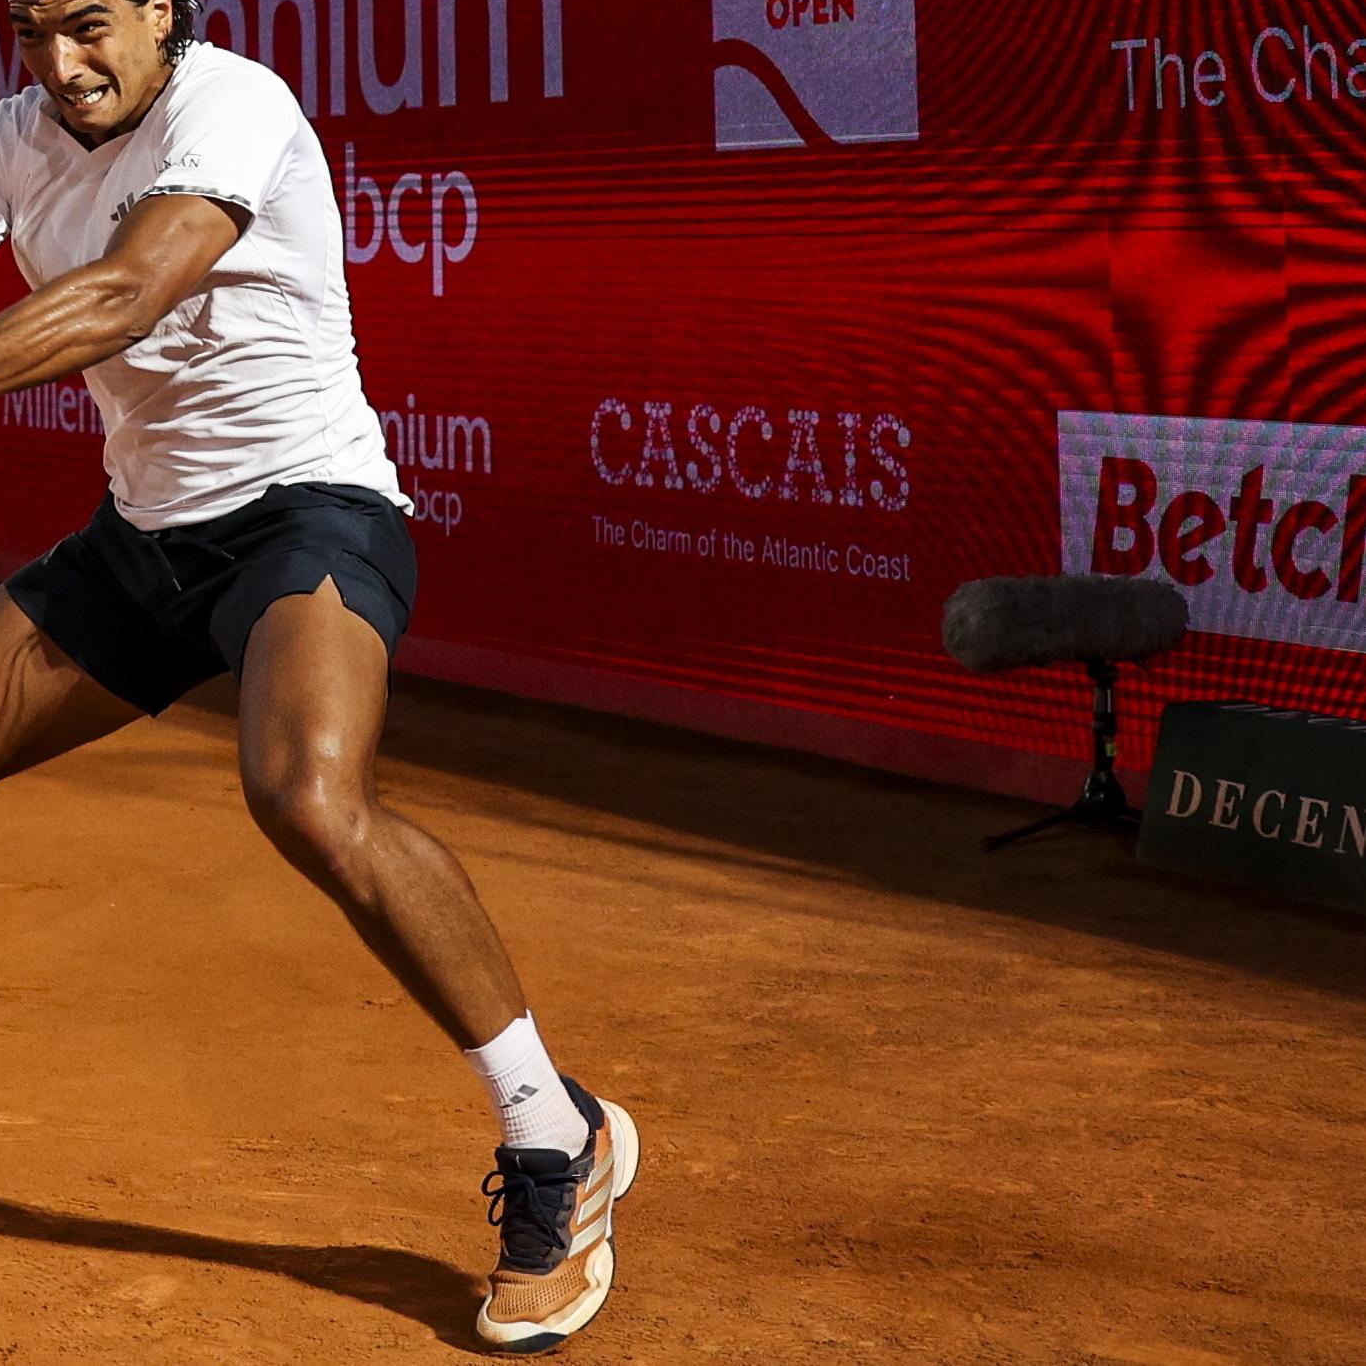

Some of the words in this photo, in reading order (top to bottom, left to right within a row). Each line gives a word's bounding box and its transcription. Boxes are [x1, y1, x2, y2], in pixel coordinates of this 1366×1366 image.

[1110, 37, 1227, 112] The
[345, 142, 479, 298] bcp
[590, 398, 911, 511] CASCAIS
[414, 476, 462, 537] bcp
[592, 515, 625, 545] The
[631, 519, 691, 554] Charm
[697, 528, 718, 557] of
[723, 532, 755, 562] the
[761, 535, 840, 573] Atlantic
[845, 544, 911, 582] Coast
